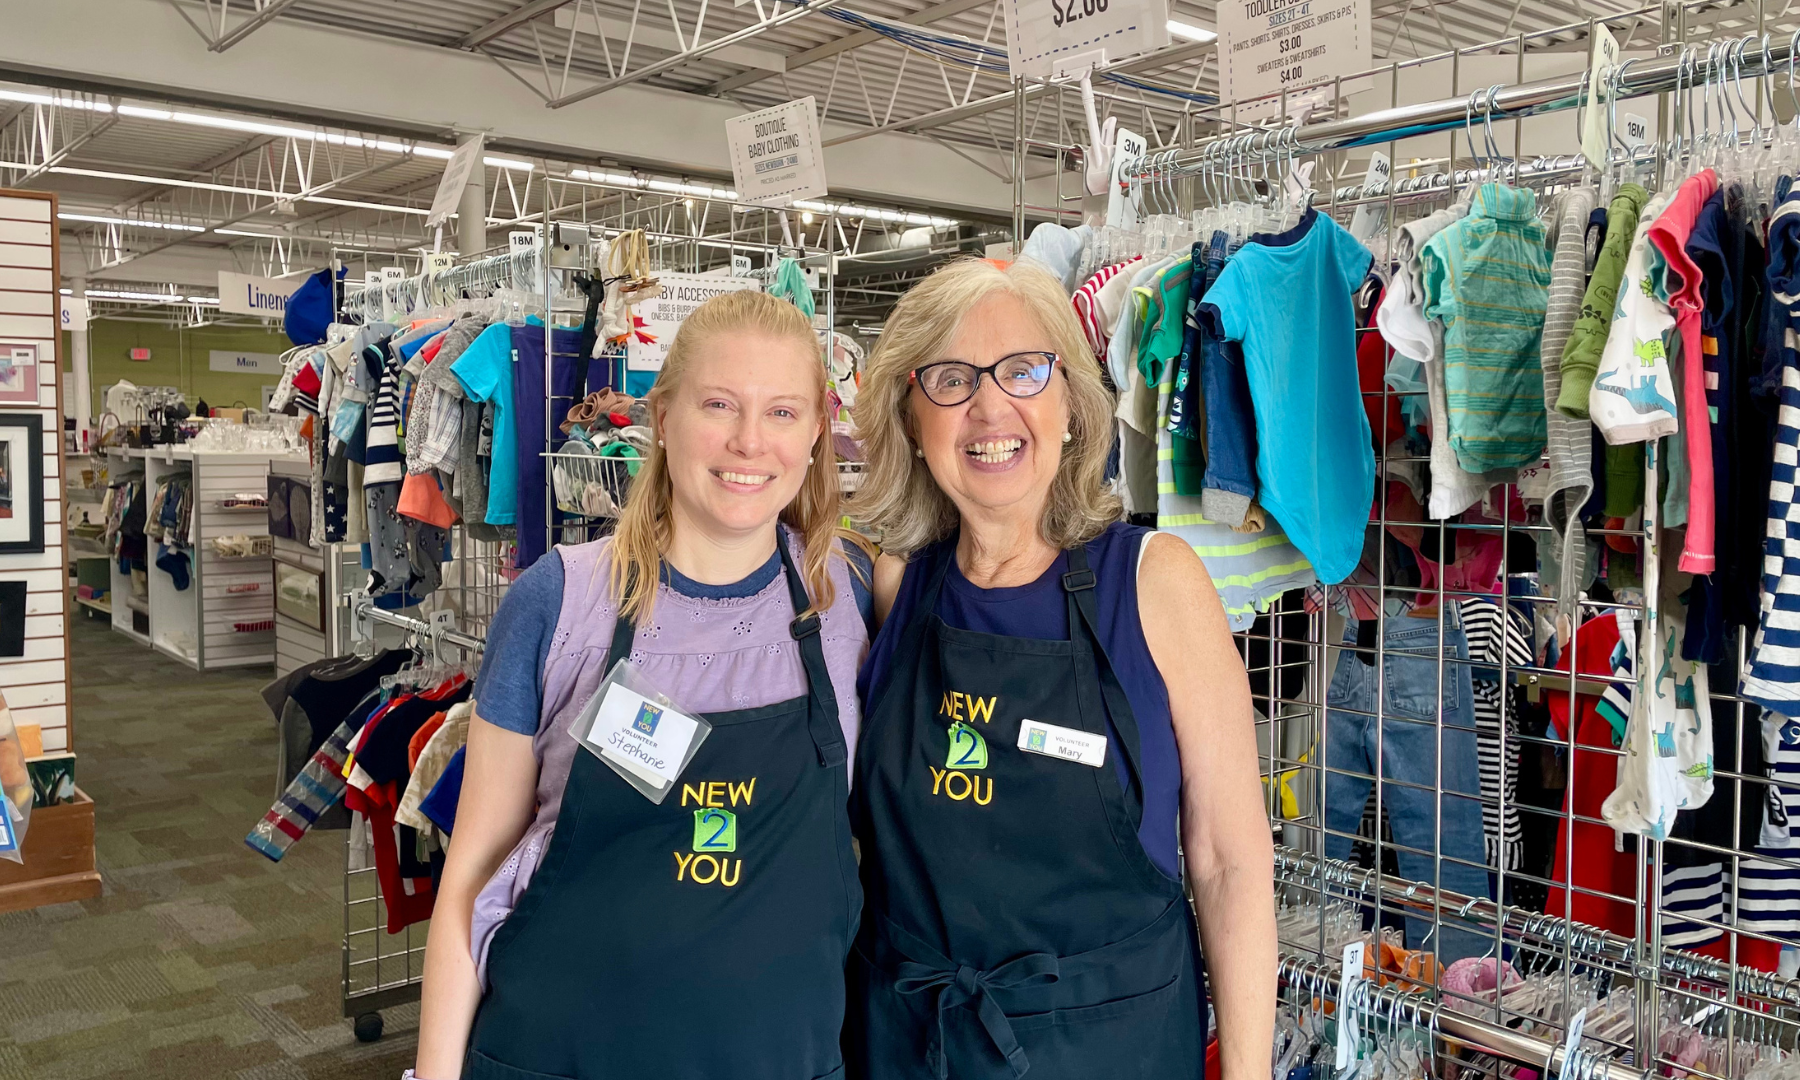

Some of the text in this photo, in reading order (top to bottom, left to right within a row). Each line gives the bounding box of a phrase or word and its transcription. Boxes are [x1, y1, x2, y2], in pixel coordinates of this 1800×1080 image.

[1269, 12, 1286, 27] SIZES
[1288, 8, 1296, 20] 2T
[1301, 3, 1309, 15] 4T
[1250, 33, 1271, 48] SHORTS,
[1271, 26, 1291, 41] SHIRTS,
[1317, 11, 1336, 26] SKIRTS
[1341, 5, 1352, 17] PJS
[1279, 35, 1302, 54] $3.00
[1257, 57, 1284, 74] SWEATERS
[1289, 45, 1326, 64] SWEATSHIRTS
[1280, 65, 1303, 84] $4.00
[754, 117, 787, 138] BOUTIQUE
[1627, 121, 1645, 140] 18M
[748, 134, 799, 158] BABY CLOTHING
[1124, 138, 1141, 157] 3M
[512, 235, 533, 246] 18M
[434, 258, 448, 267] 12M
[735, 259, 747, 268] 6M
[387, 271, 401, 279] 6M
[658, 303, 671, 312] BIBS
[236, 356, 258, 367] Men
[437, 614, 448, 623] 4T
[643, 703, 660, 715] NEW
[939, 690, 997, 724] NEW
[637, 721, 652, 733] YOU
[621, 727, 658, 748] VOLUNTEER
[954, 728, 980, 765] 2
[1055, 736, 1090, 748] VOLUNTEER
[607, 731, 665, 770] Stephanie
[1058, 746, 1083, 760] Mary
[681, 777, 757, 807] NEW
[929, 765, 993, 806] YOU
[701, 813, 729, 847] 2
[673, 851, 742, 887] YOU
[1350, 949, 1358, 964] 3T
